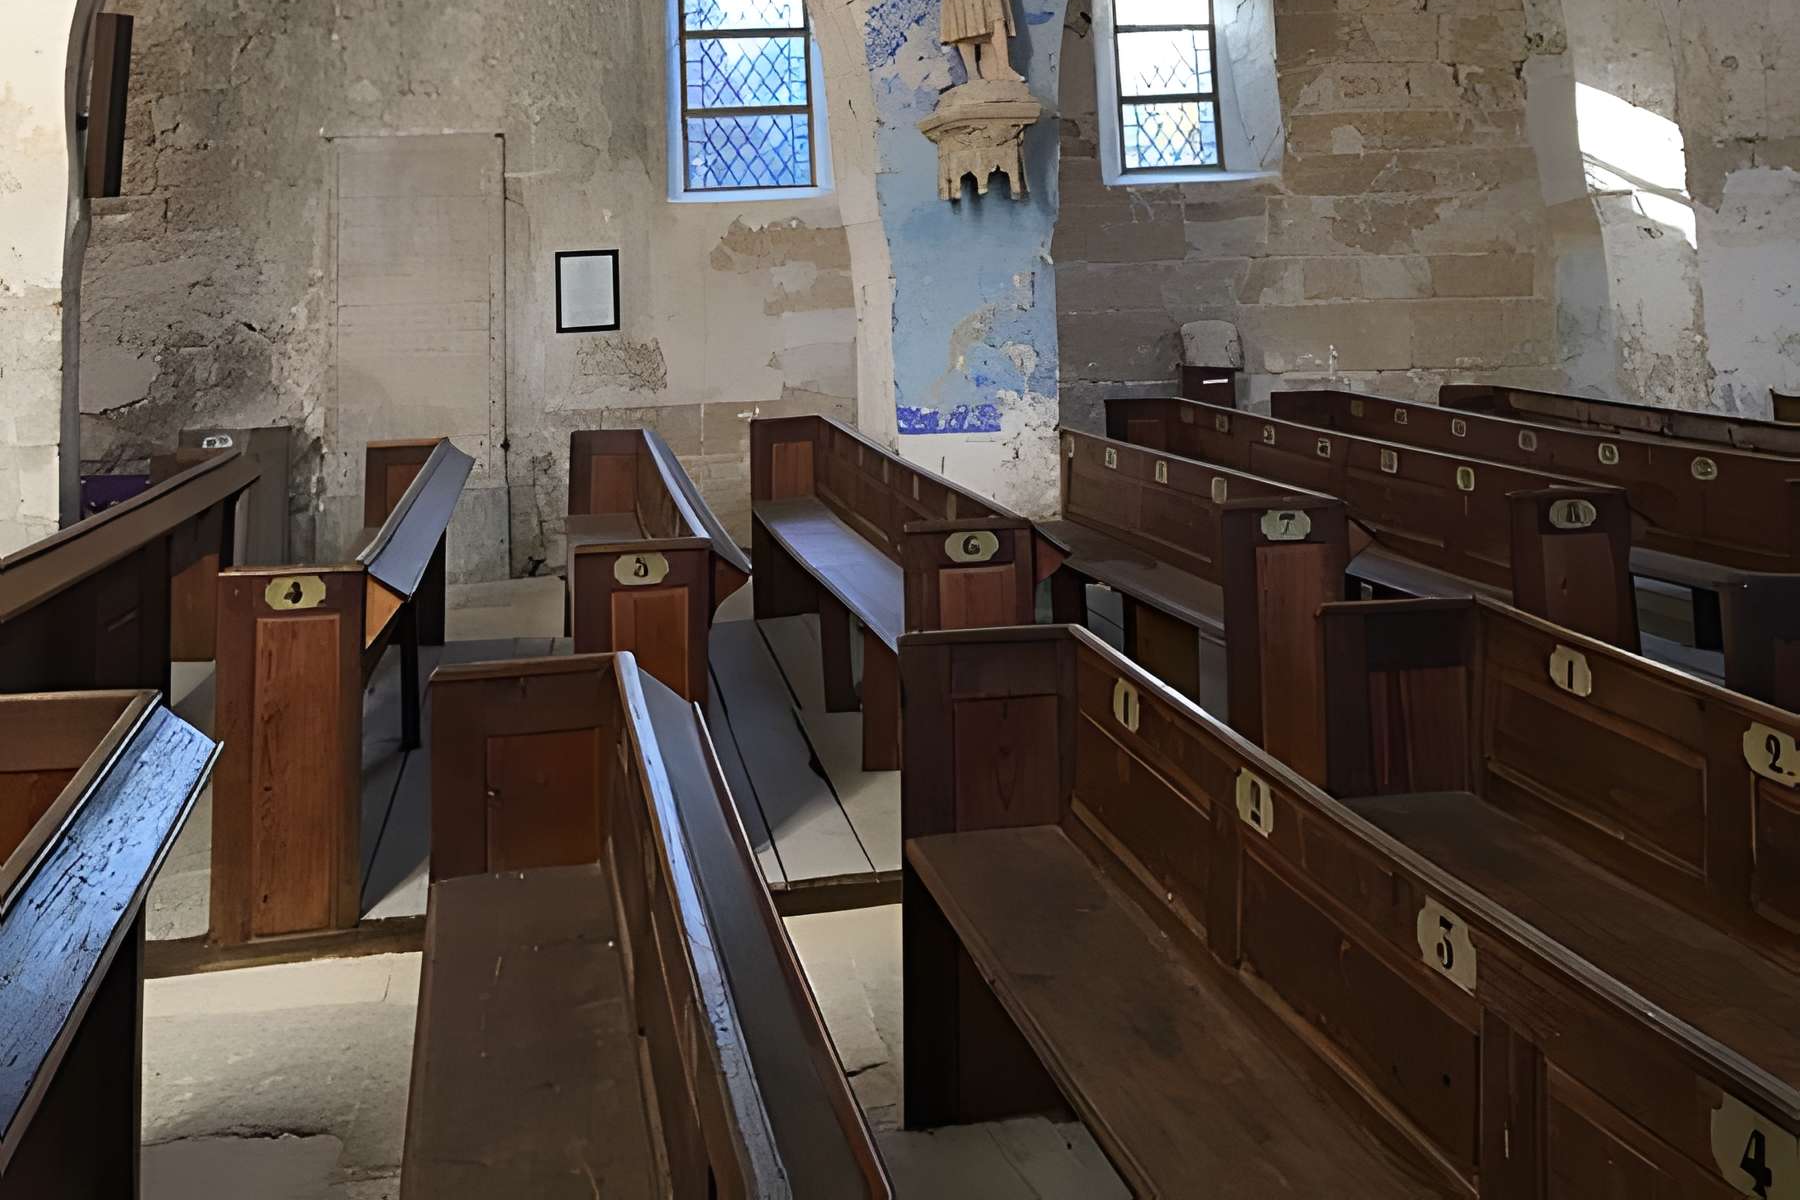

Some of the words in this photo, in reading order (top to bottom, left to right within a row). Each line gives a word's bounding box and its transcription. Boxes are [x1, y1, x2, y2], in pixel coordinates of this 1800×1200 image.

[1279, 513, 1295, 536] 7
[963, 536, 981, 555] 6
[1567, 660, 1573, 690] 1
[1437, 915, 1453, 970] 3
[1740, 1129, 1772, 1200] 4
